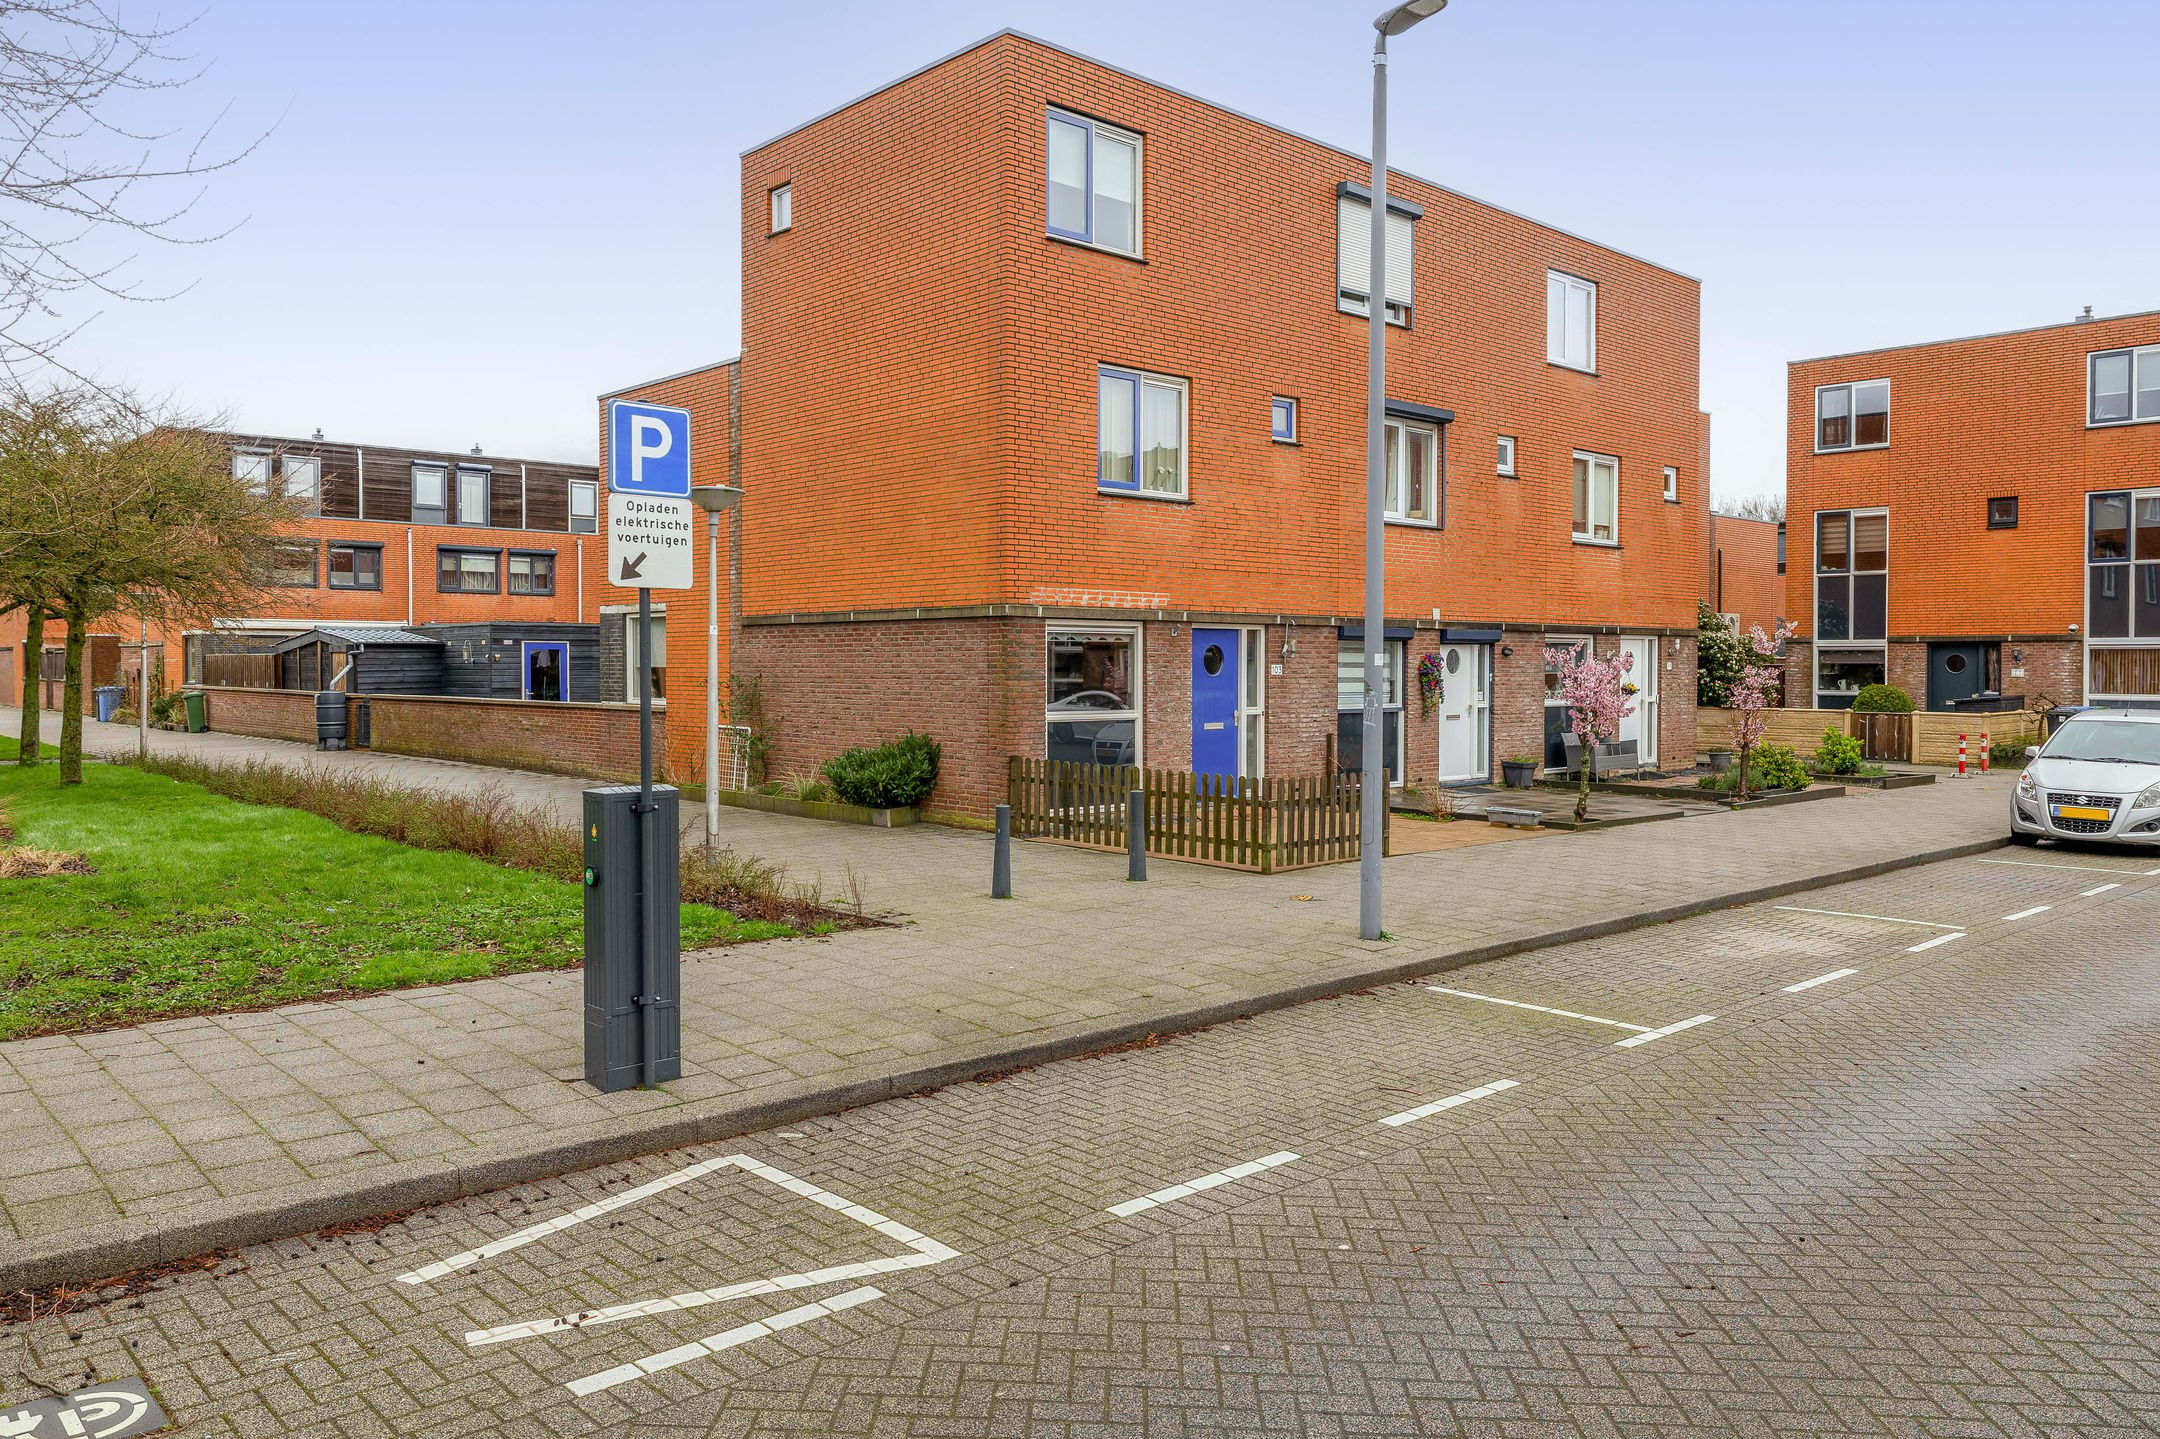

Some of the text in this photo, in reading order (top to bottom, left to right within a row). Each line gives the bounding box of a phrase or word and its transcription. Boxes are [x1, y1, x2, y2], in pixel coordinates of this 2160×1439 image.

[631, 415, 673, 482] P
[626, 500, 679, 515] Opladen
[615, 516, 689, 531] elektrische
[617, 533, 688, 548] voertuigen
[1271, 665, 1282, 674] 103
